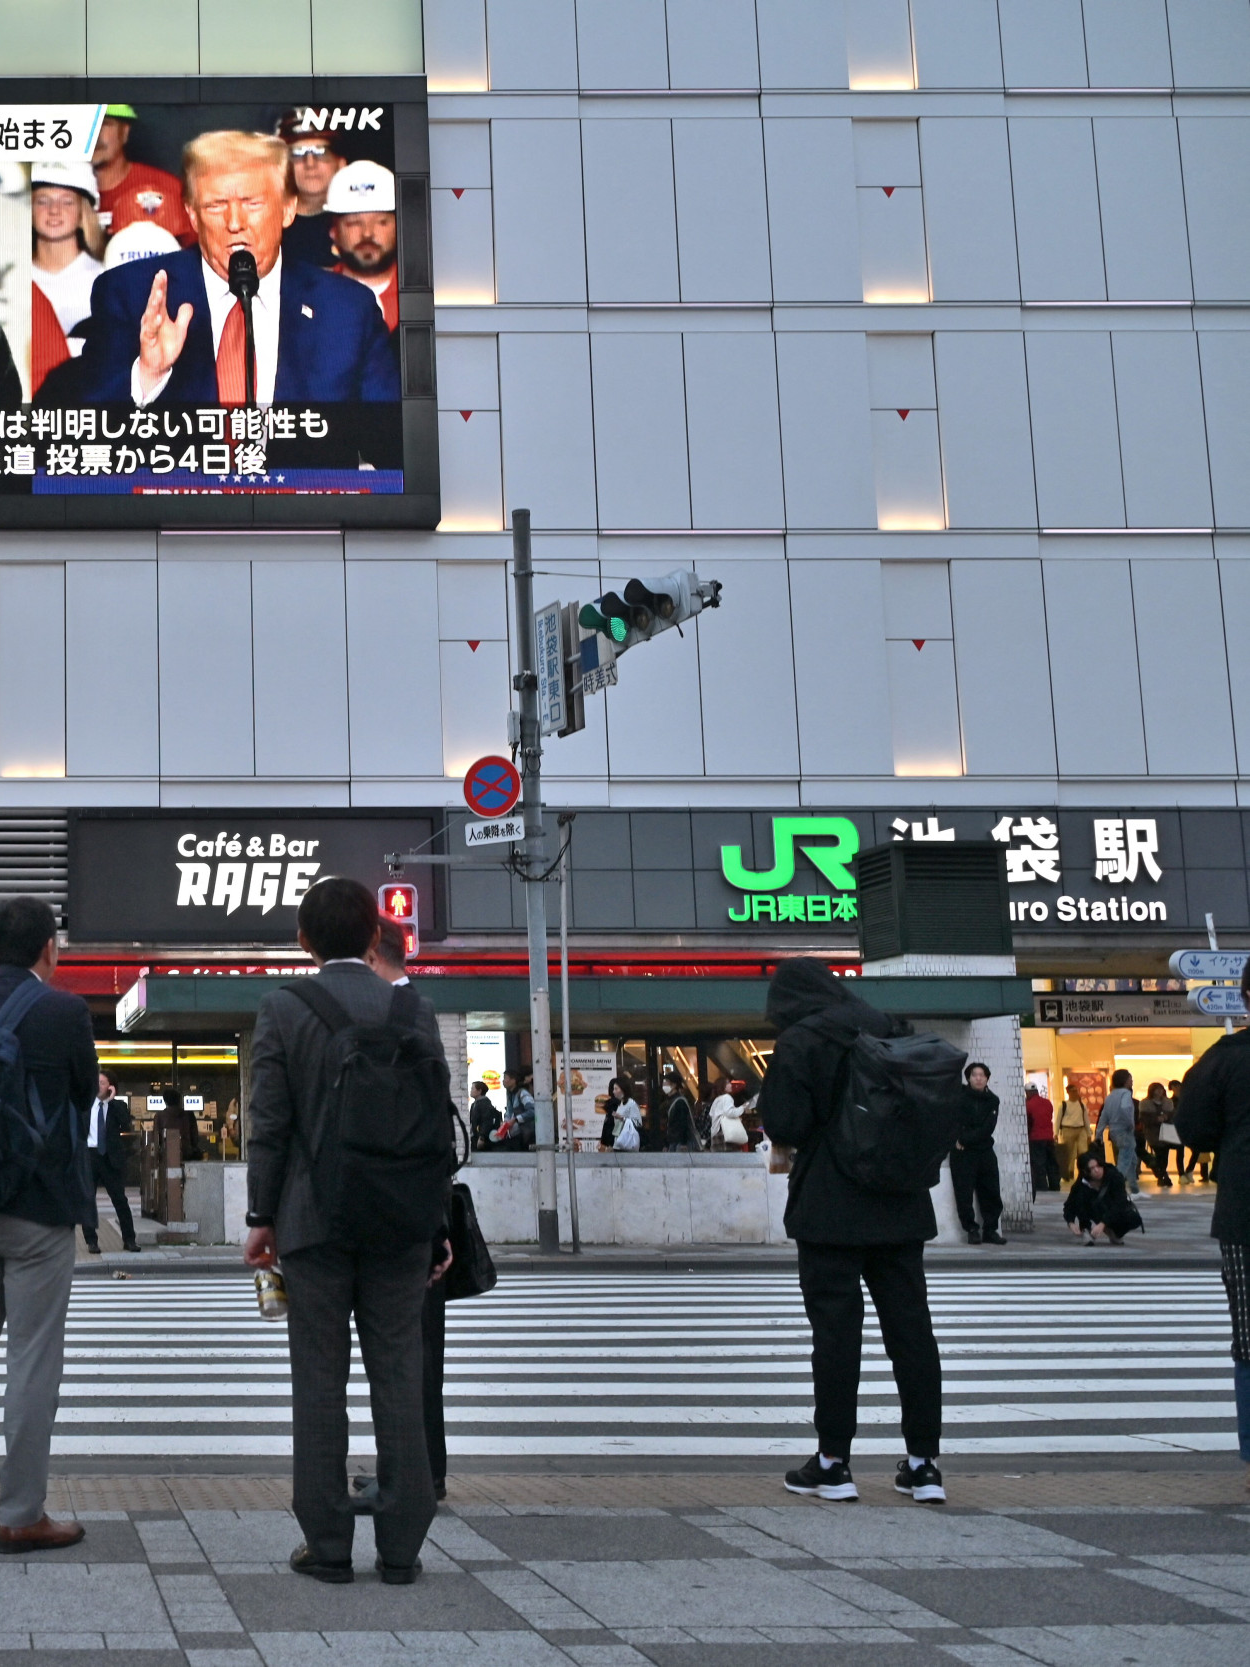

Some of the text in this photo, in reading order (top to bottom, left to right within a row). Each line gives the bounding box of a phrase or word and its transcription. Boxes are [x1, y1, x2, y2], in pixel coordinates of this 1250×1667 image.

[300, 107, 384, 131] NHK
[46, 444, 267, 476] 投票から4日後
[537, 618, 546, 674] Ikebukuro
[545, 612, 561, 723] 池袋駅東口
[583, 659, 618, 693] 時差式
[177, 831, 319, 858] Café & Bar
[469, 823, 521, 841] 人の乗降を除く
[721, 817, 859, 891] JR
[175, 862, 321, 917] RAGE
[728, 894, 858, 922] JR東日本
[1056, 896, 1167, 922] Station
[1065, 1000, 1104, 1012] 池袋駅
[1065, 1013, 1112, 1023] Ikebukuro
[1115, 1012, 1149, 1023] Station
